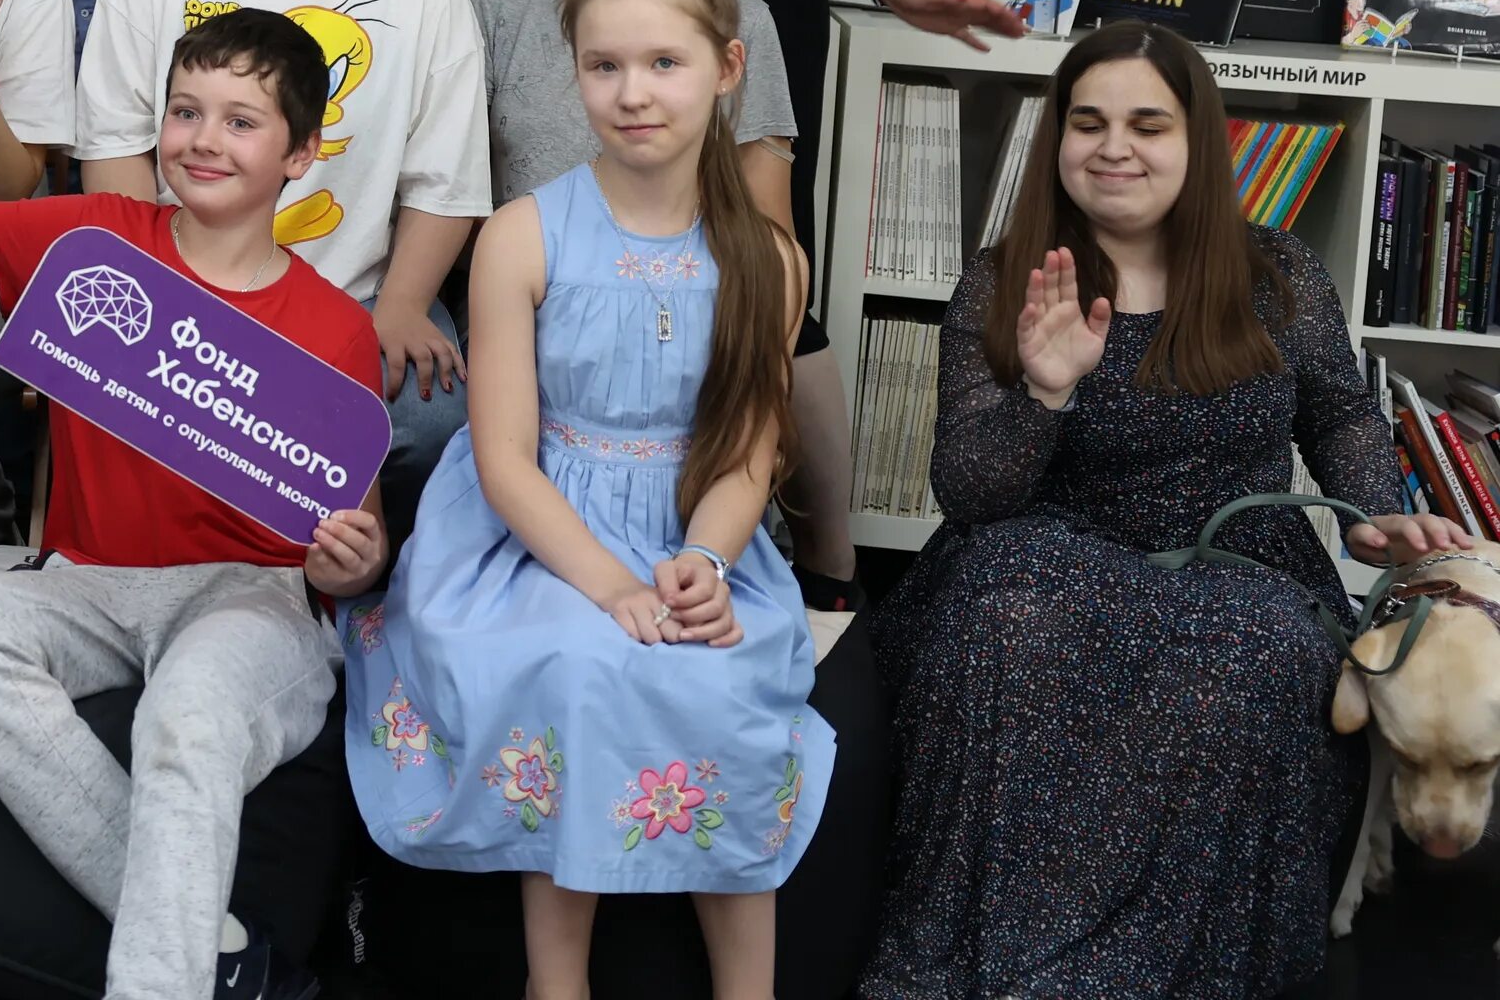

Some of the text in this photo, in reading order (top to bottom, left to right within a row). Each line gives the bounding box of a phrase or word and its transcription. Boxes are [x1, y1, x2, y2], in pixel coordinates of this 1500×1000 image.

[1207, 62, 1367, 86] ОЯЗЫЧНЫЙ МИР
[169, 315, 260, 397] Фонд
[29, 329, 331, 520] Помощь детям с опухолями мозга
[146, 349, 348, 490] Хабенского
[1442, 418, 1458, 447] KVINNOR
[1465, 461, 1477, 479] BARA
[1474, 480, 1488, 502] SERIER
[1485, 502, 1494, 517] OM
